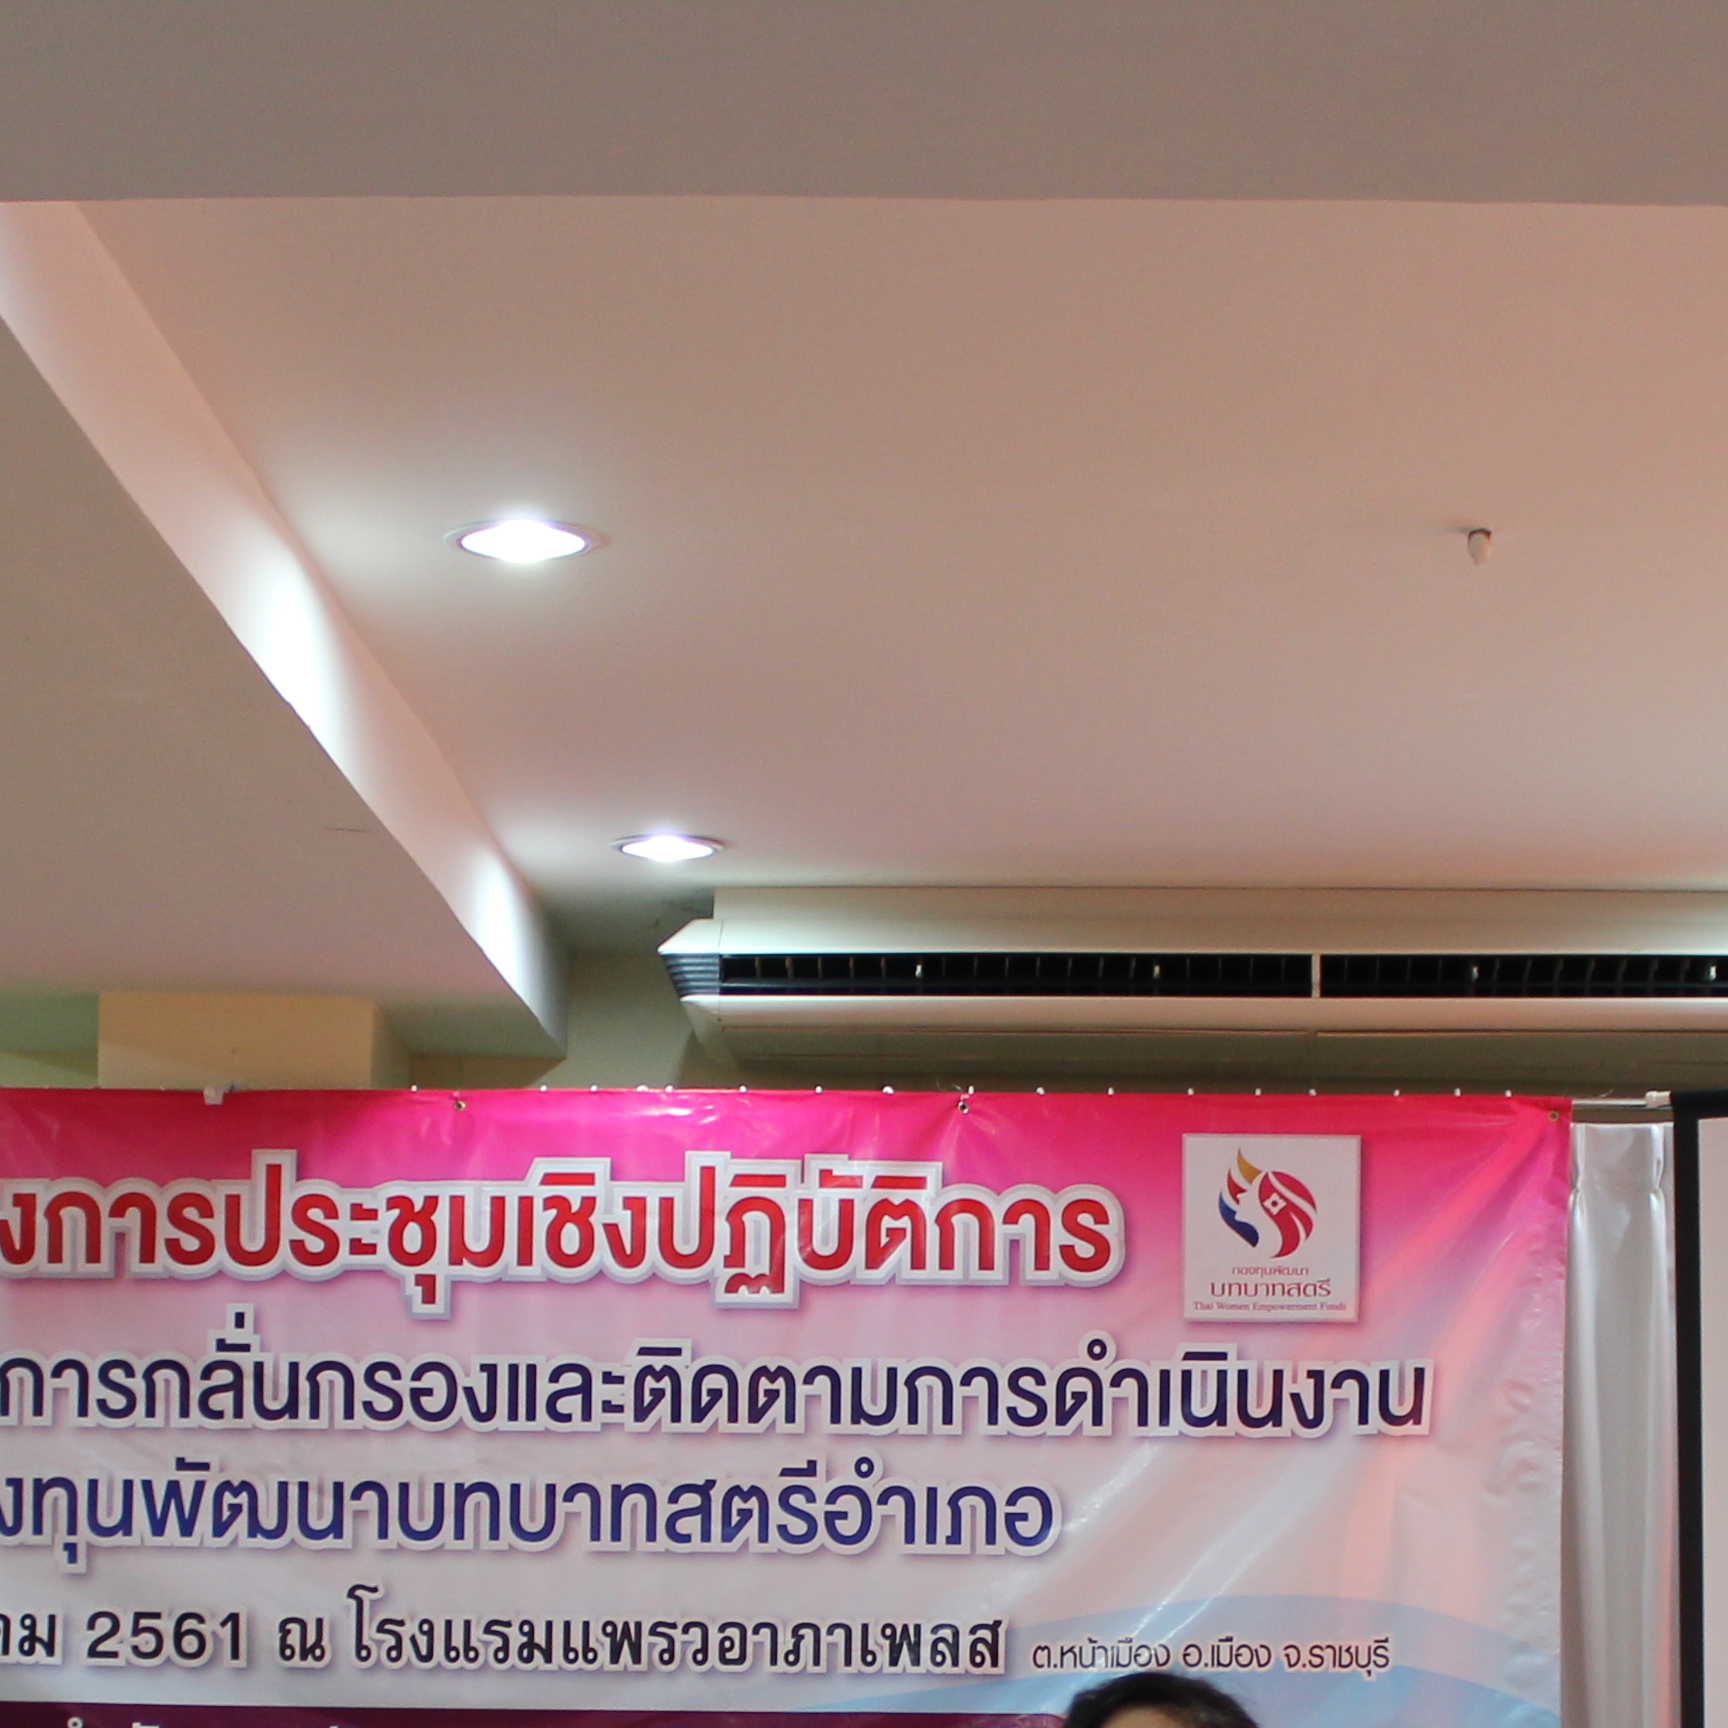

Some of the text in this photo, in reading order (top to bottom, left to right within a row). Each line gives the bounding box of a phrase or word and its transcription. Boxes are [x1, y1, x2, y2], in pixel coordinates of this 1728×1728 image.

[1231, 1265, 1309, 1279] กองทุนพัฒนา
[1209, 1278, 1333, 1298] บทบาทสตรี
[1193, 1301, 1214, 1311] Thai
[86, 1609, 243, 1661] 2561
[277, 1615, 325, 1662] ณ
[346, 1585, 1003, 1670] โรงแรมแพรวอาภาเพลส
[1031, 1636, 1171, 1669] ต.หน้าเมือง
[1182, 1636, 1272, 1669] อ.เมือง
[1282, 1636, 1391, 1677] จ.ราชบุรี
